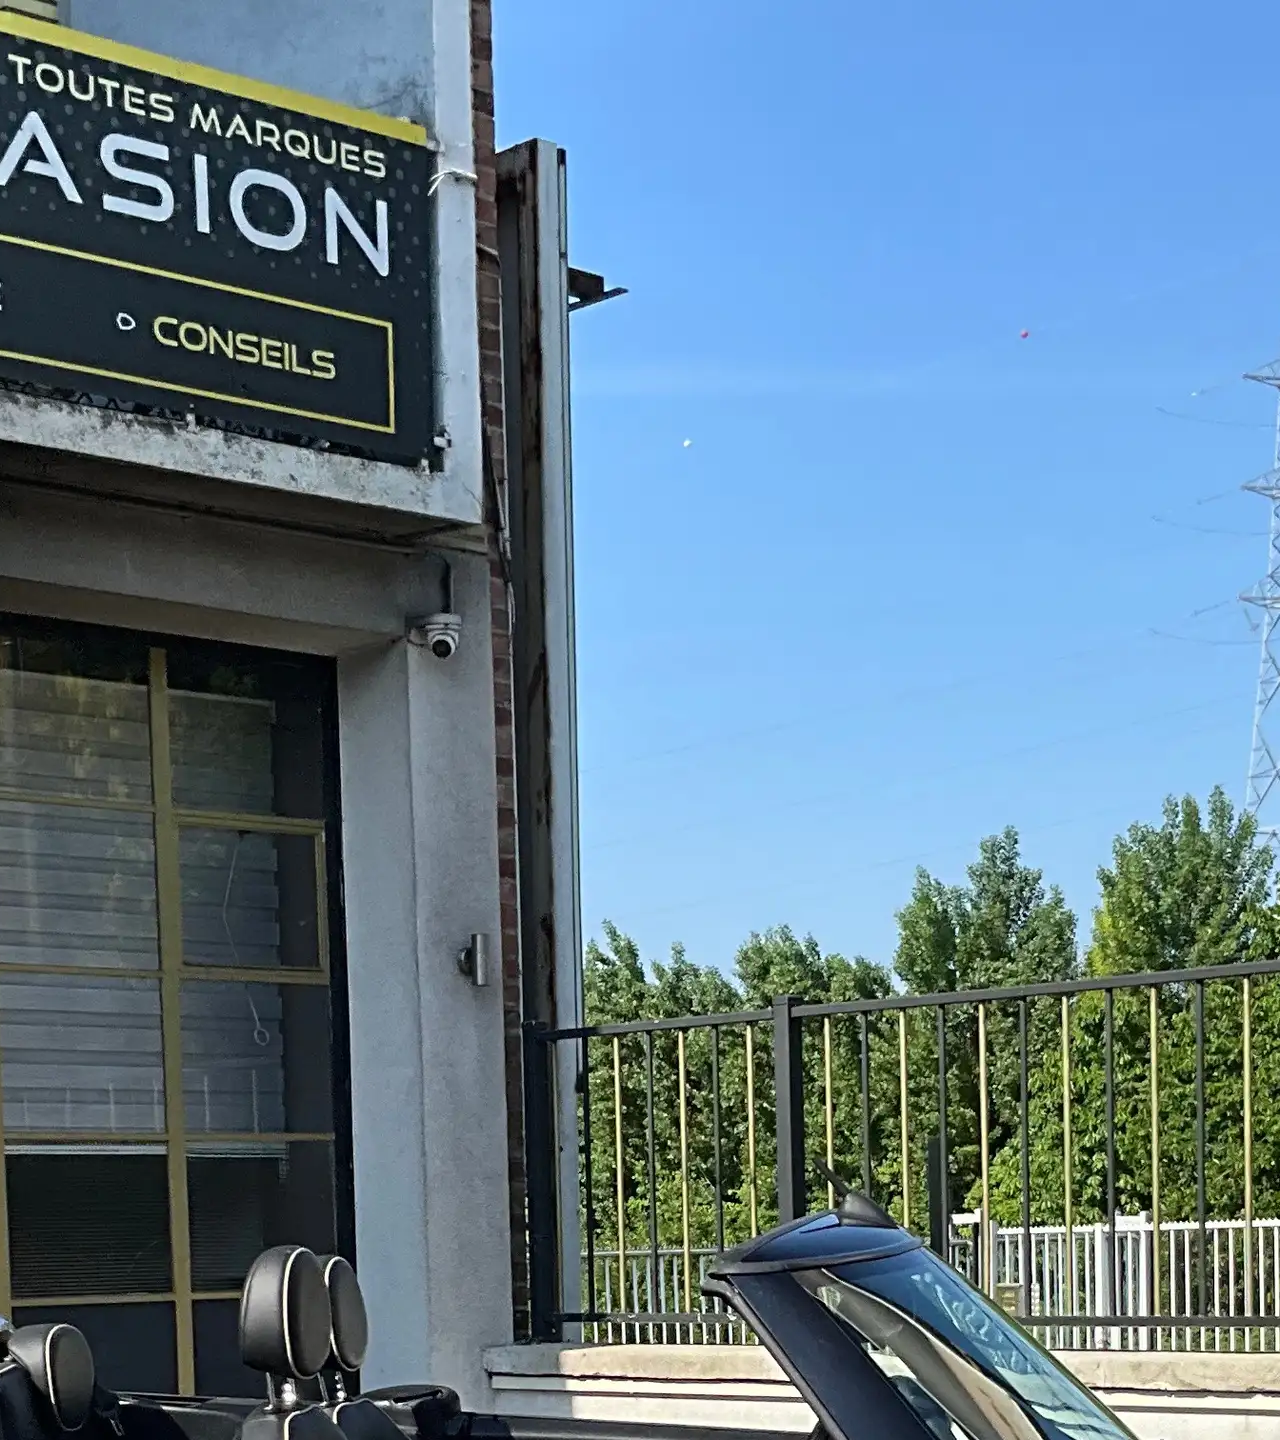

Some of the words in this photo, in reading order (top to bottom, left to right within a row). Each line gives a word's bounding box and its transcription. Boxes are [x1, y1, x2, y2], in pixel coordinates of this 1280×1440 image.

[7, 53, 175, 123] TOUTES
[189, 103, 386, 178] MARQUES
[153, 316, 336, 379] CONSEILS
